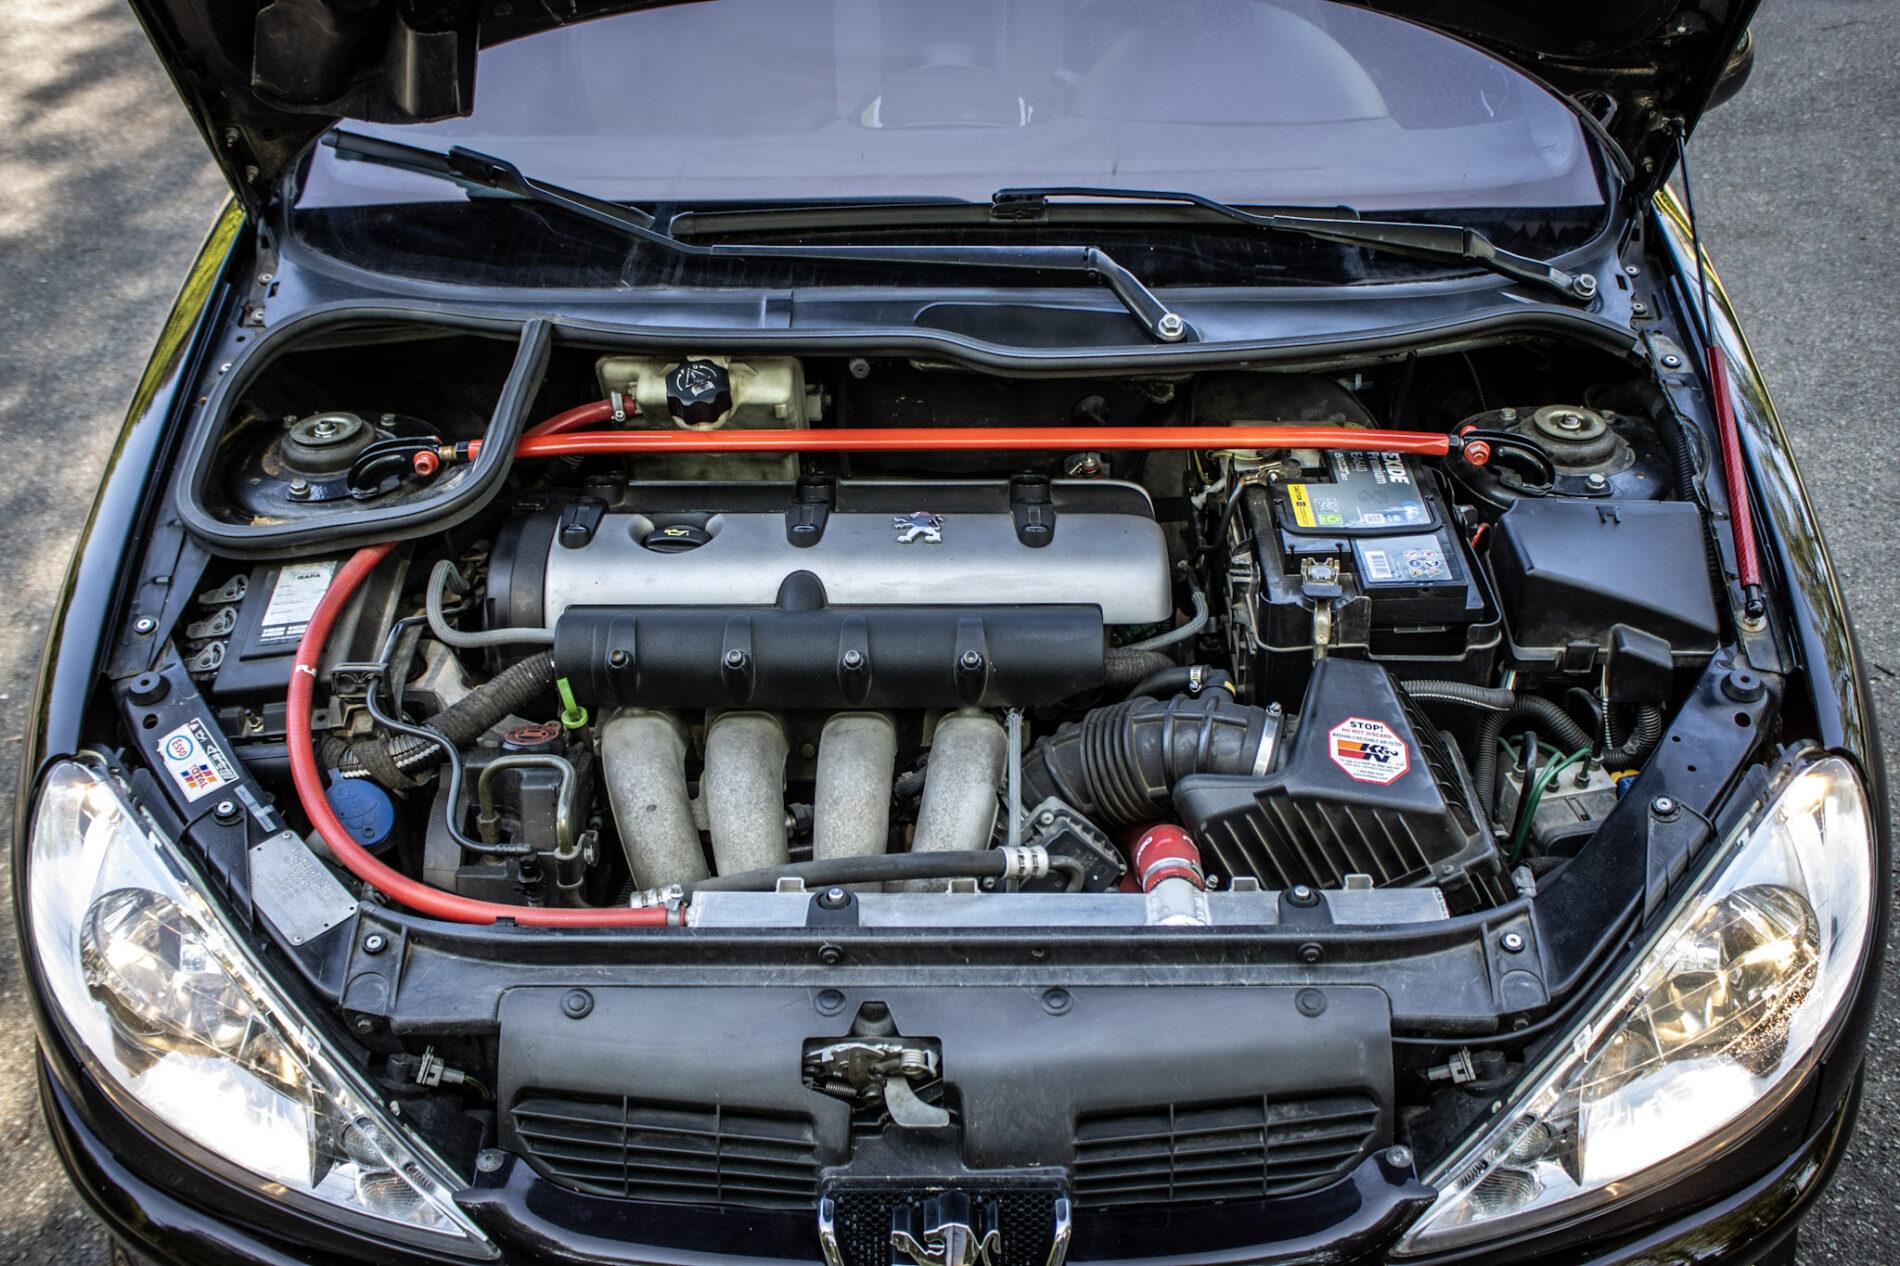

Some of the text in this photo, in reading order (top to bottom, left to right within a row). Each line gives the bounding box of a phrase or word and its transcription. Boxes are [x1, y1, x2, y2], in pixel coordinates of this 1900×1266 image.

[1366, 452, 1387, 484] Premium
[1381, 452, 1410, 485] EXIDE
[1350, 721, 1383, 732] STOP!
[1360, 743, 1399, 763] K&N
[190, 764, 208, 789] TOTAL
